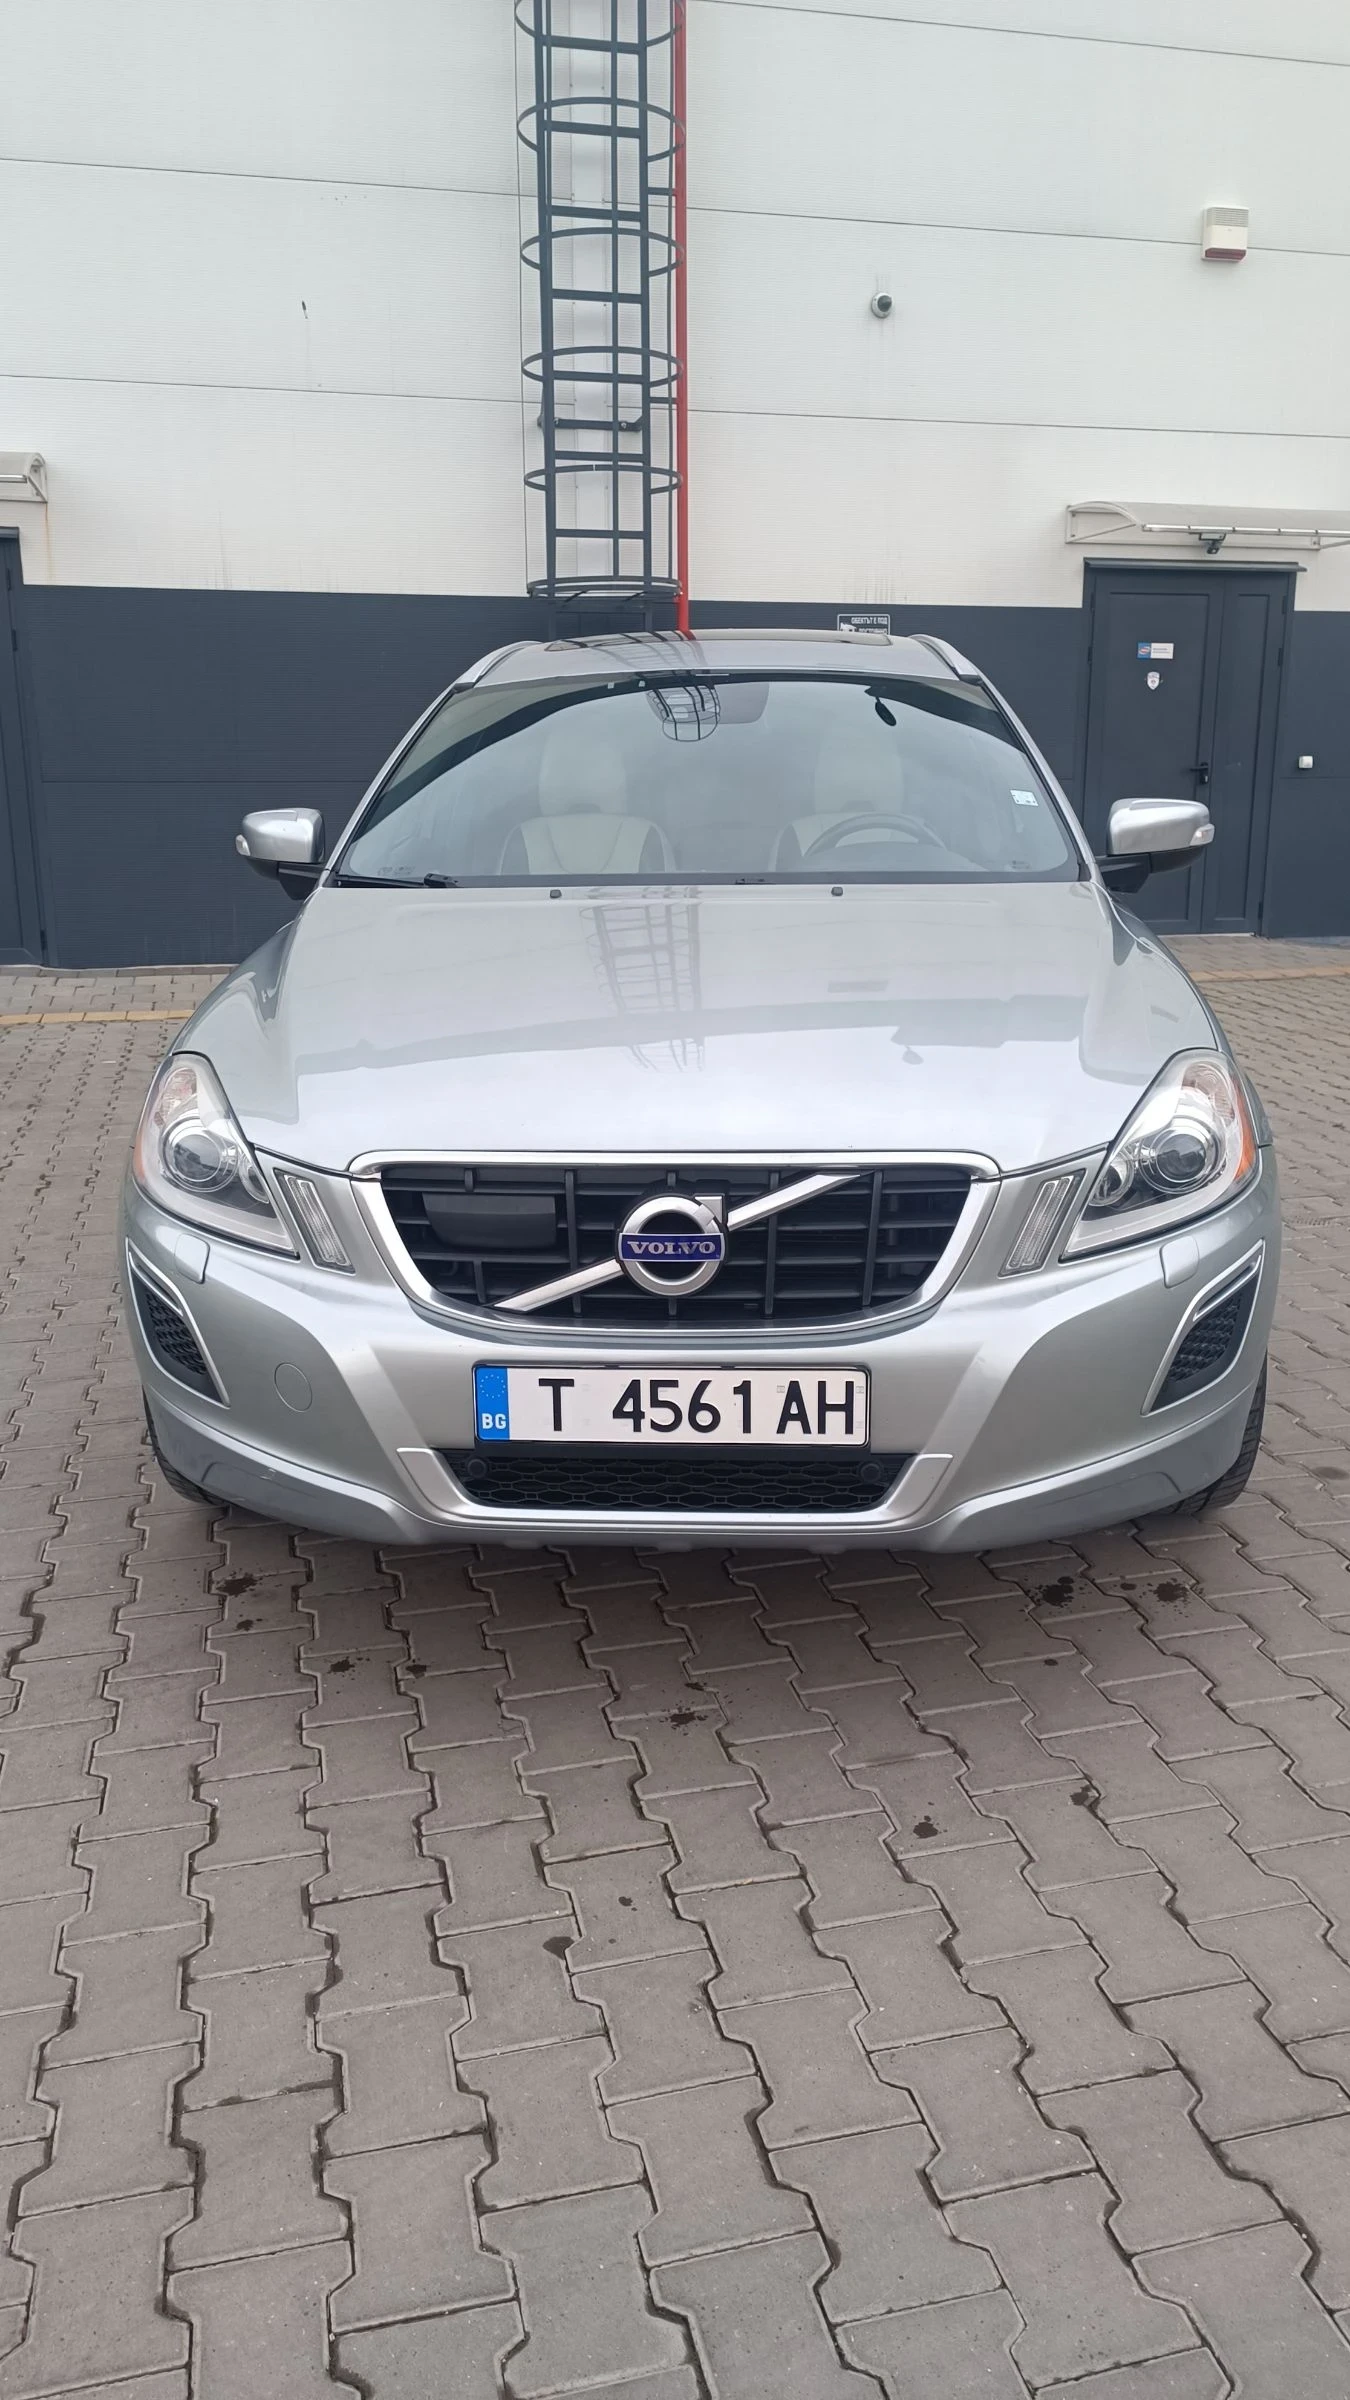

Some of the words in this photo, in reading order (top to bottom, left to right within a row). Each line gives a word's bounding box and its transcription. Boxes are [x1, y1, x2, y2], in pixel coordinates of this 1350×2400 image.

[627, 1241, 716, 1255] VOLVO
[538, 1378, 575, 1432] T
[612, 1379, 753, 1434] 4561
[776, 1380, 855, 1435] AH
[481, 1412, 507, 1430] BG
